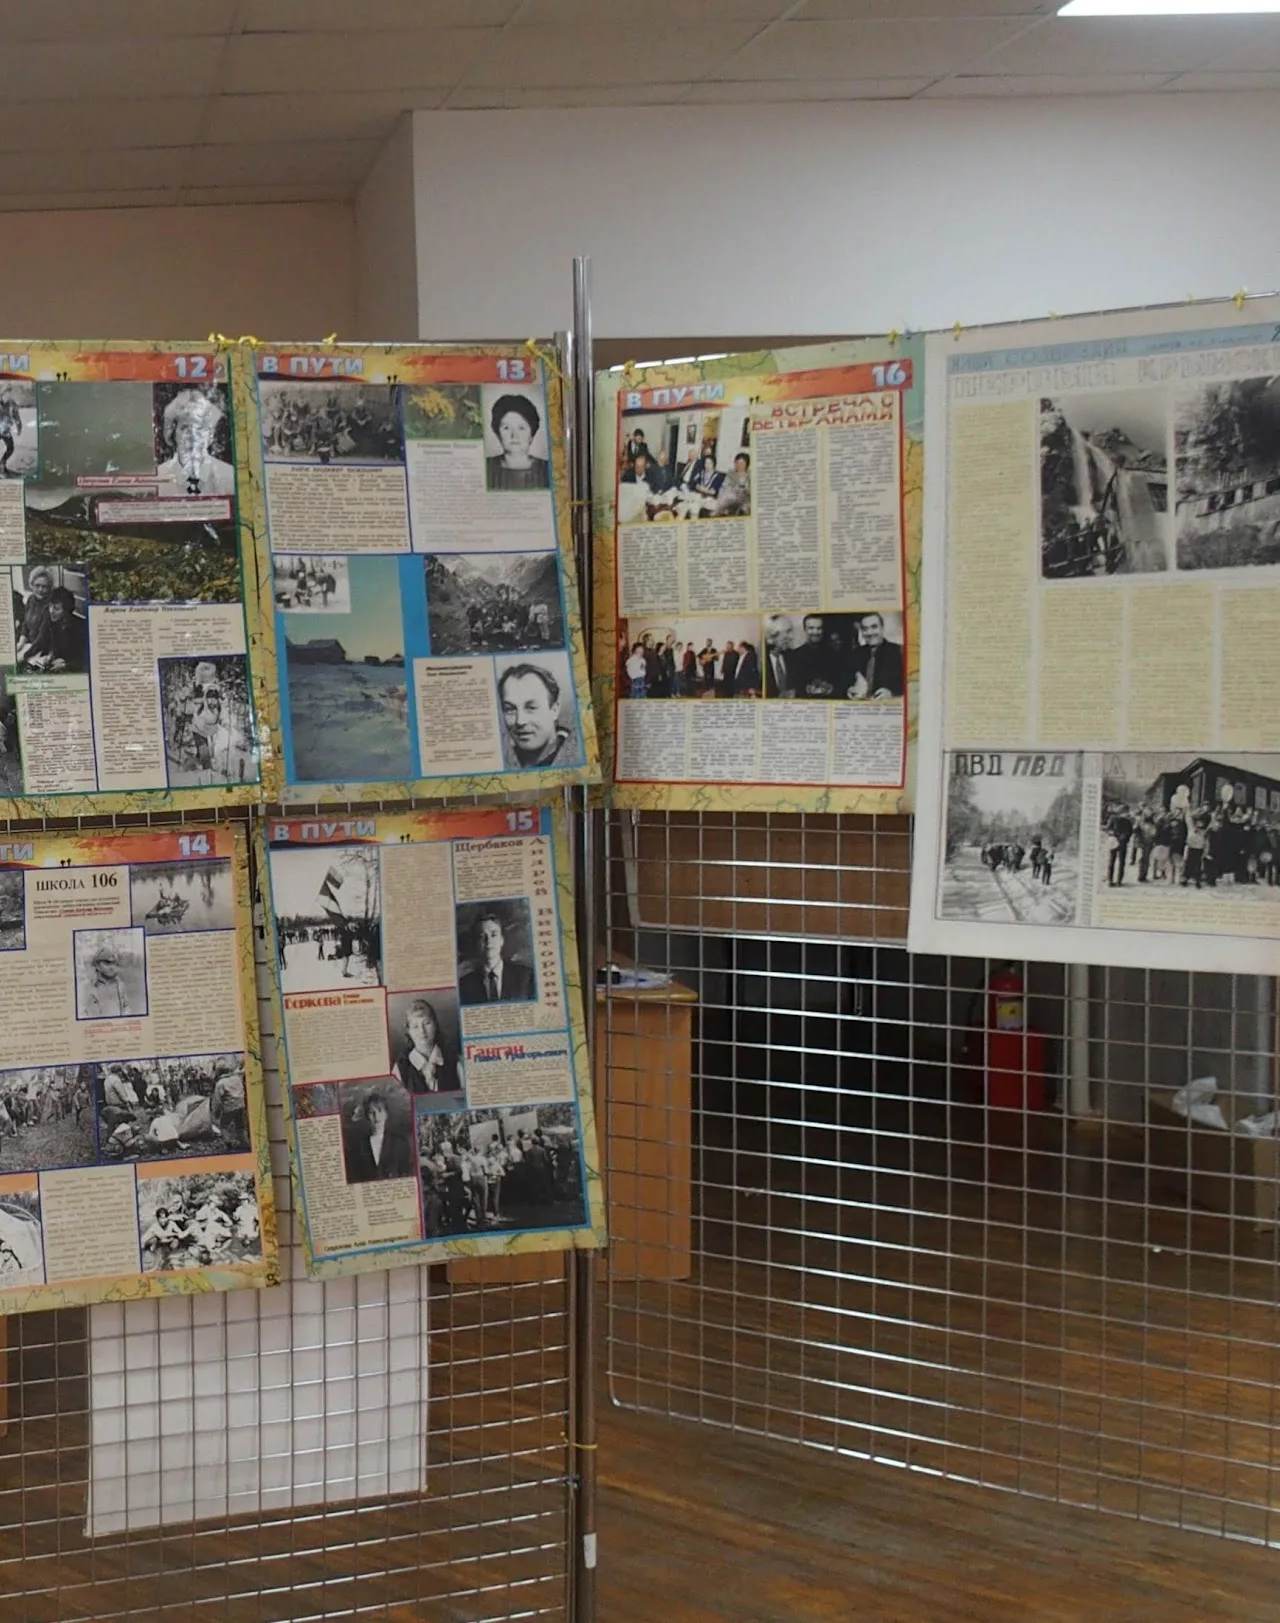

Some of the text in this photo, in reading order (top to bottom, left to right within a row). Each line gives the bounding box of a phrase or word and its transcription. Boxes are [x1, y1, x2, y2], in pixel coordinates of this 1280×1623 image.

[173, 356, 208, 377] 12
[262, 356, 526, 379] В ПУТИ 13
[627, 362, 907, 410] В ПУТИ 16
[955, 754, 1002, 776] ПВД
[1011, 754, 1065, 777] ПВД
[274, 810, 533, 841] В ПУТИ 15
[177, 834, 211, 856] 14
[455, 837, 523, 853] Щербаков
[35, 872, 118, 892] ШКОЛА 106
